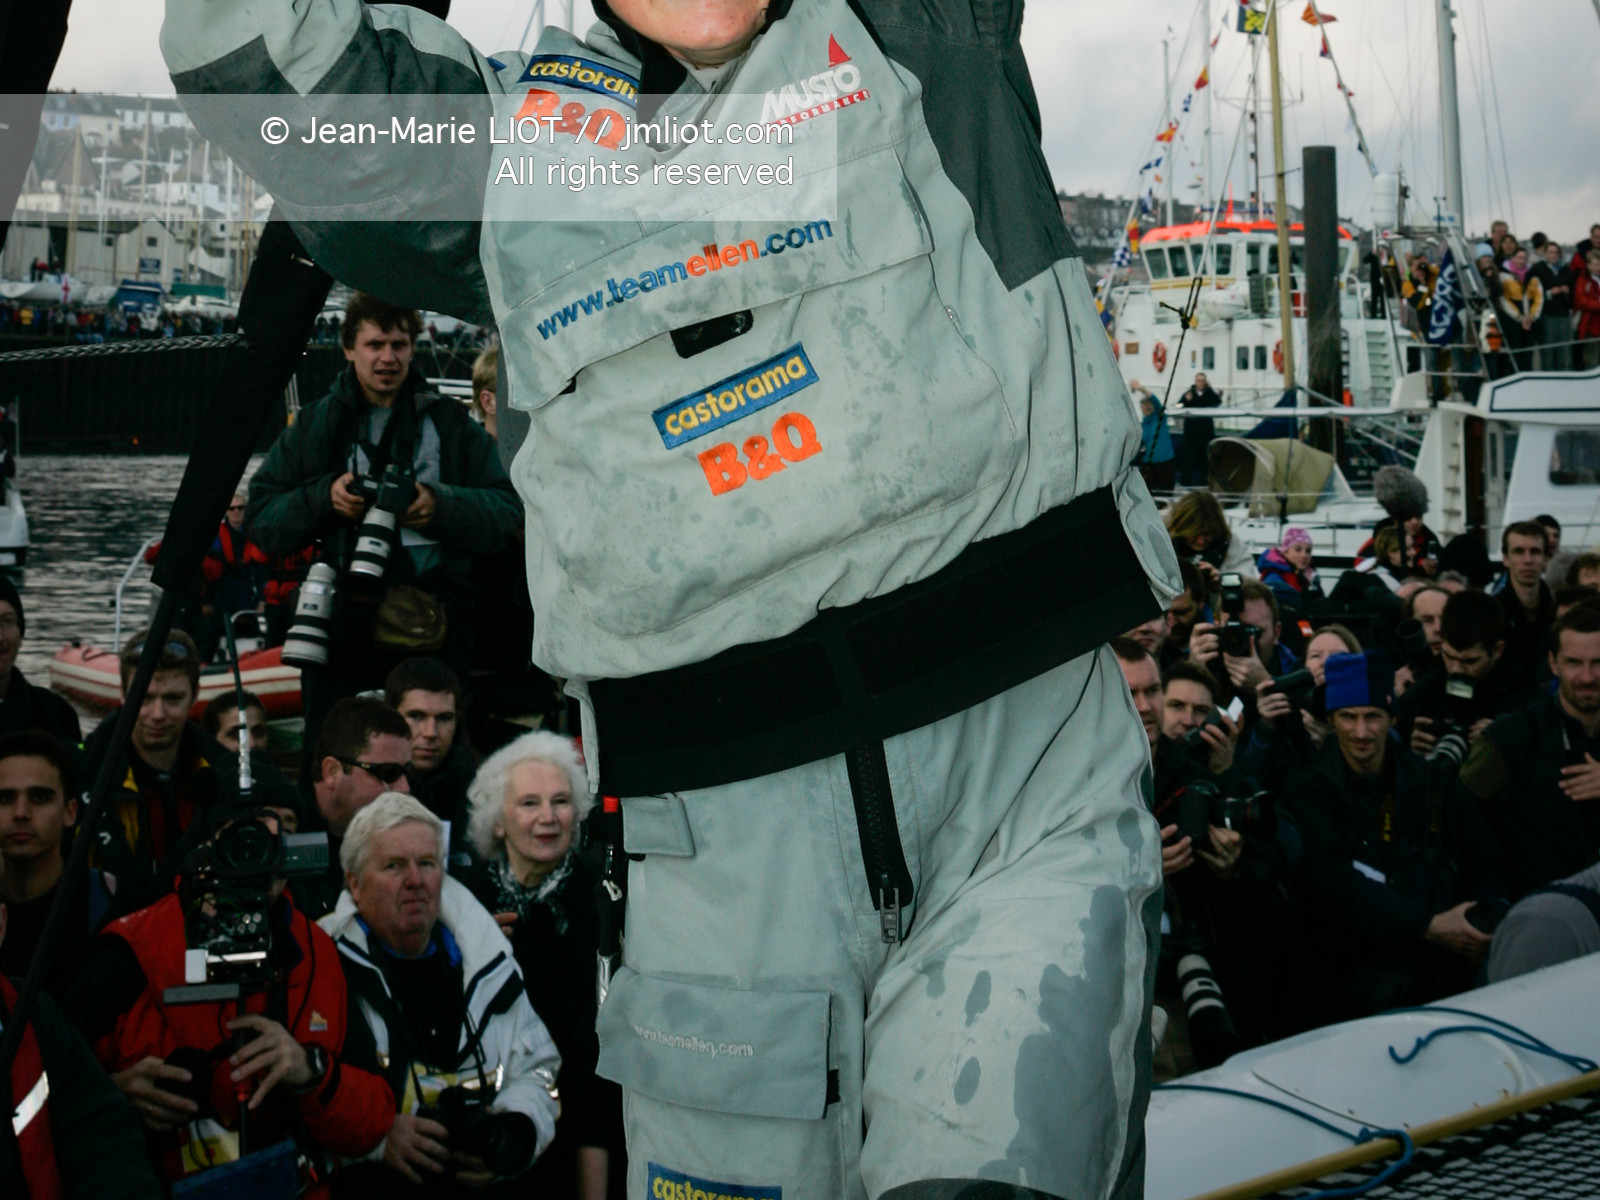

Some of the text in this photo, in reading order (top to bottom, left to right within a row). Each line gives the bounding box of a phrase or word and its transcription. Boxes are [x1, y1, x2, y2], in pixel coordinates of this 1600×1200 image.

[514, 88, 627, 151] B&Q
[760, 63, 861, 128] MUSTO
[537, 218, 834, 341] www.teamellen.com
[664, 354, 808, 436] castorama
[697, 412, 824, 497] B&Q
